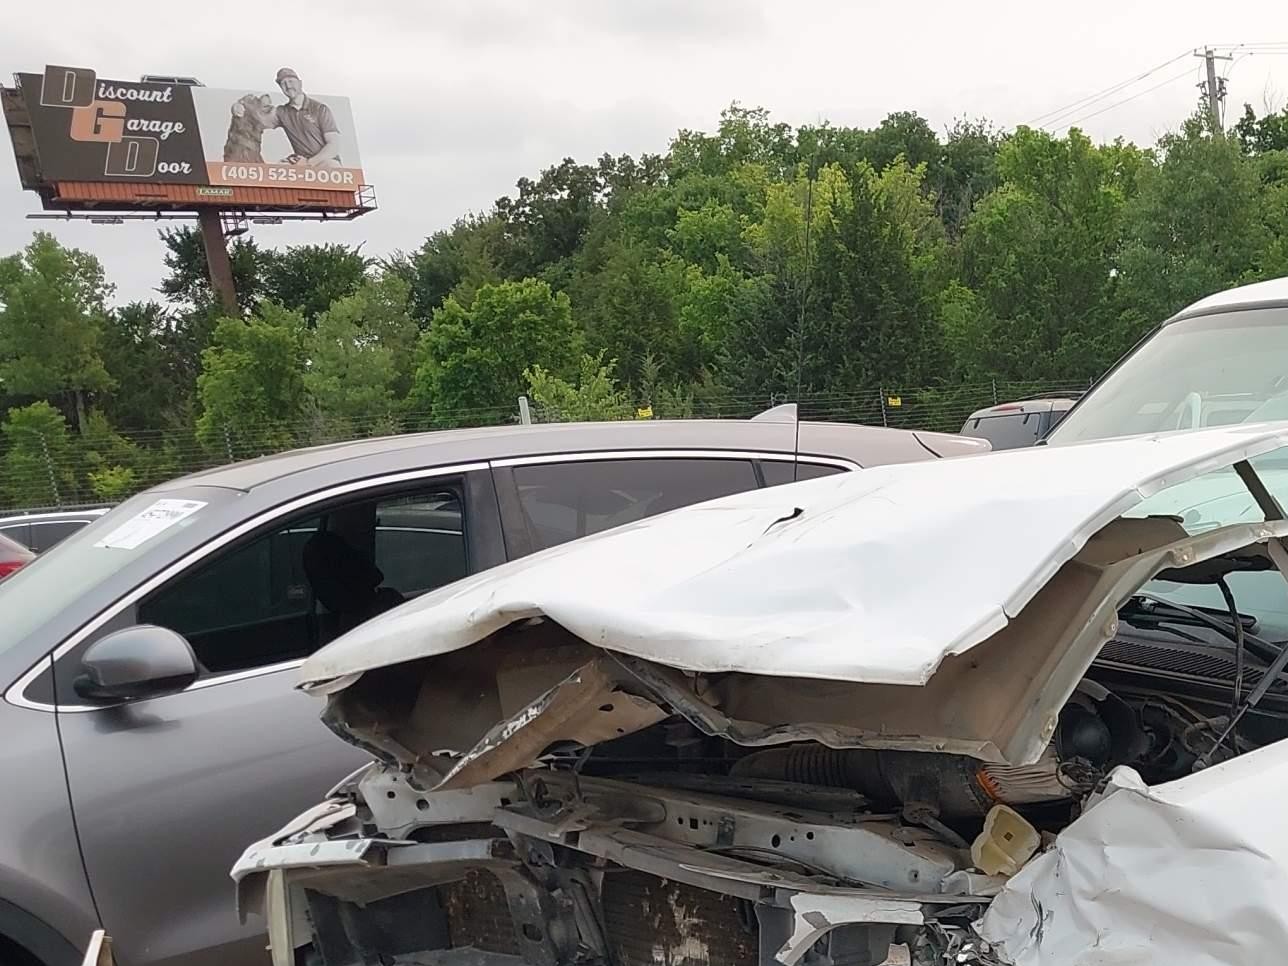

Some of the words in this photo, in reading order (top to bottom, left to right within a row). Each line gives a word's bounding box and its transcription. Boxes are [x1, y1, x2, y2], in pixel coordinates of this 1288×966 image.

[40, 64, 173, 108] Discount
[70, 100, 186, 143] Garage
[104, 136, 192, 177] Door
[220, 165, 264, 182] (405)
[268, 167, 354, 185] 525-DOOR
